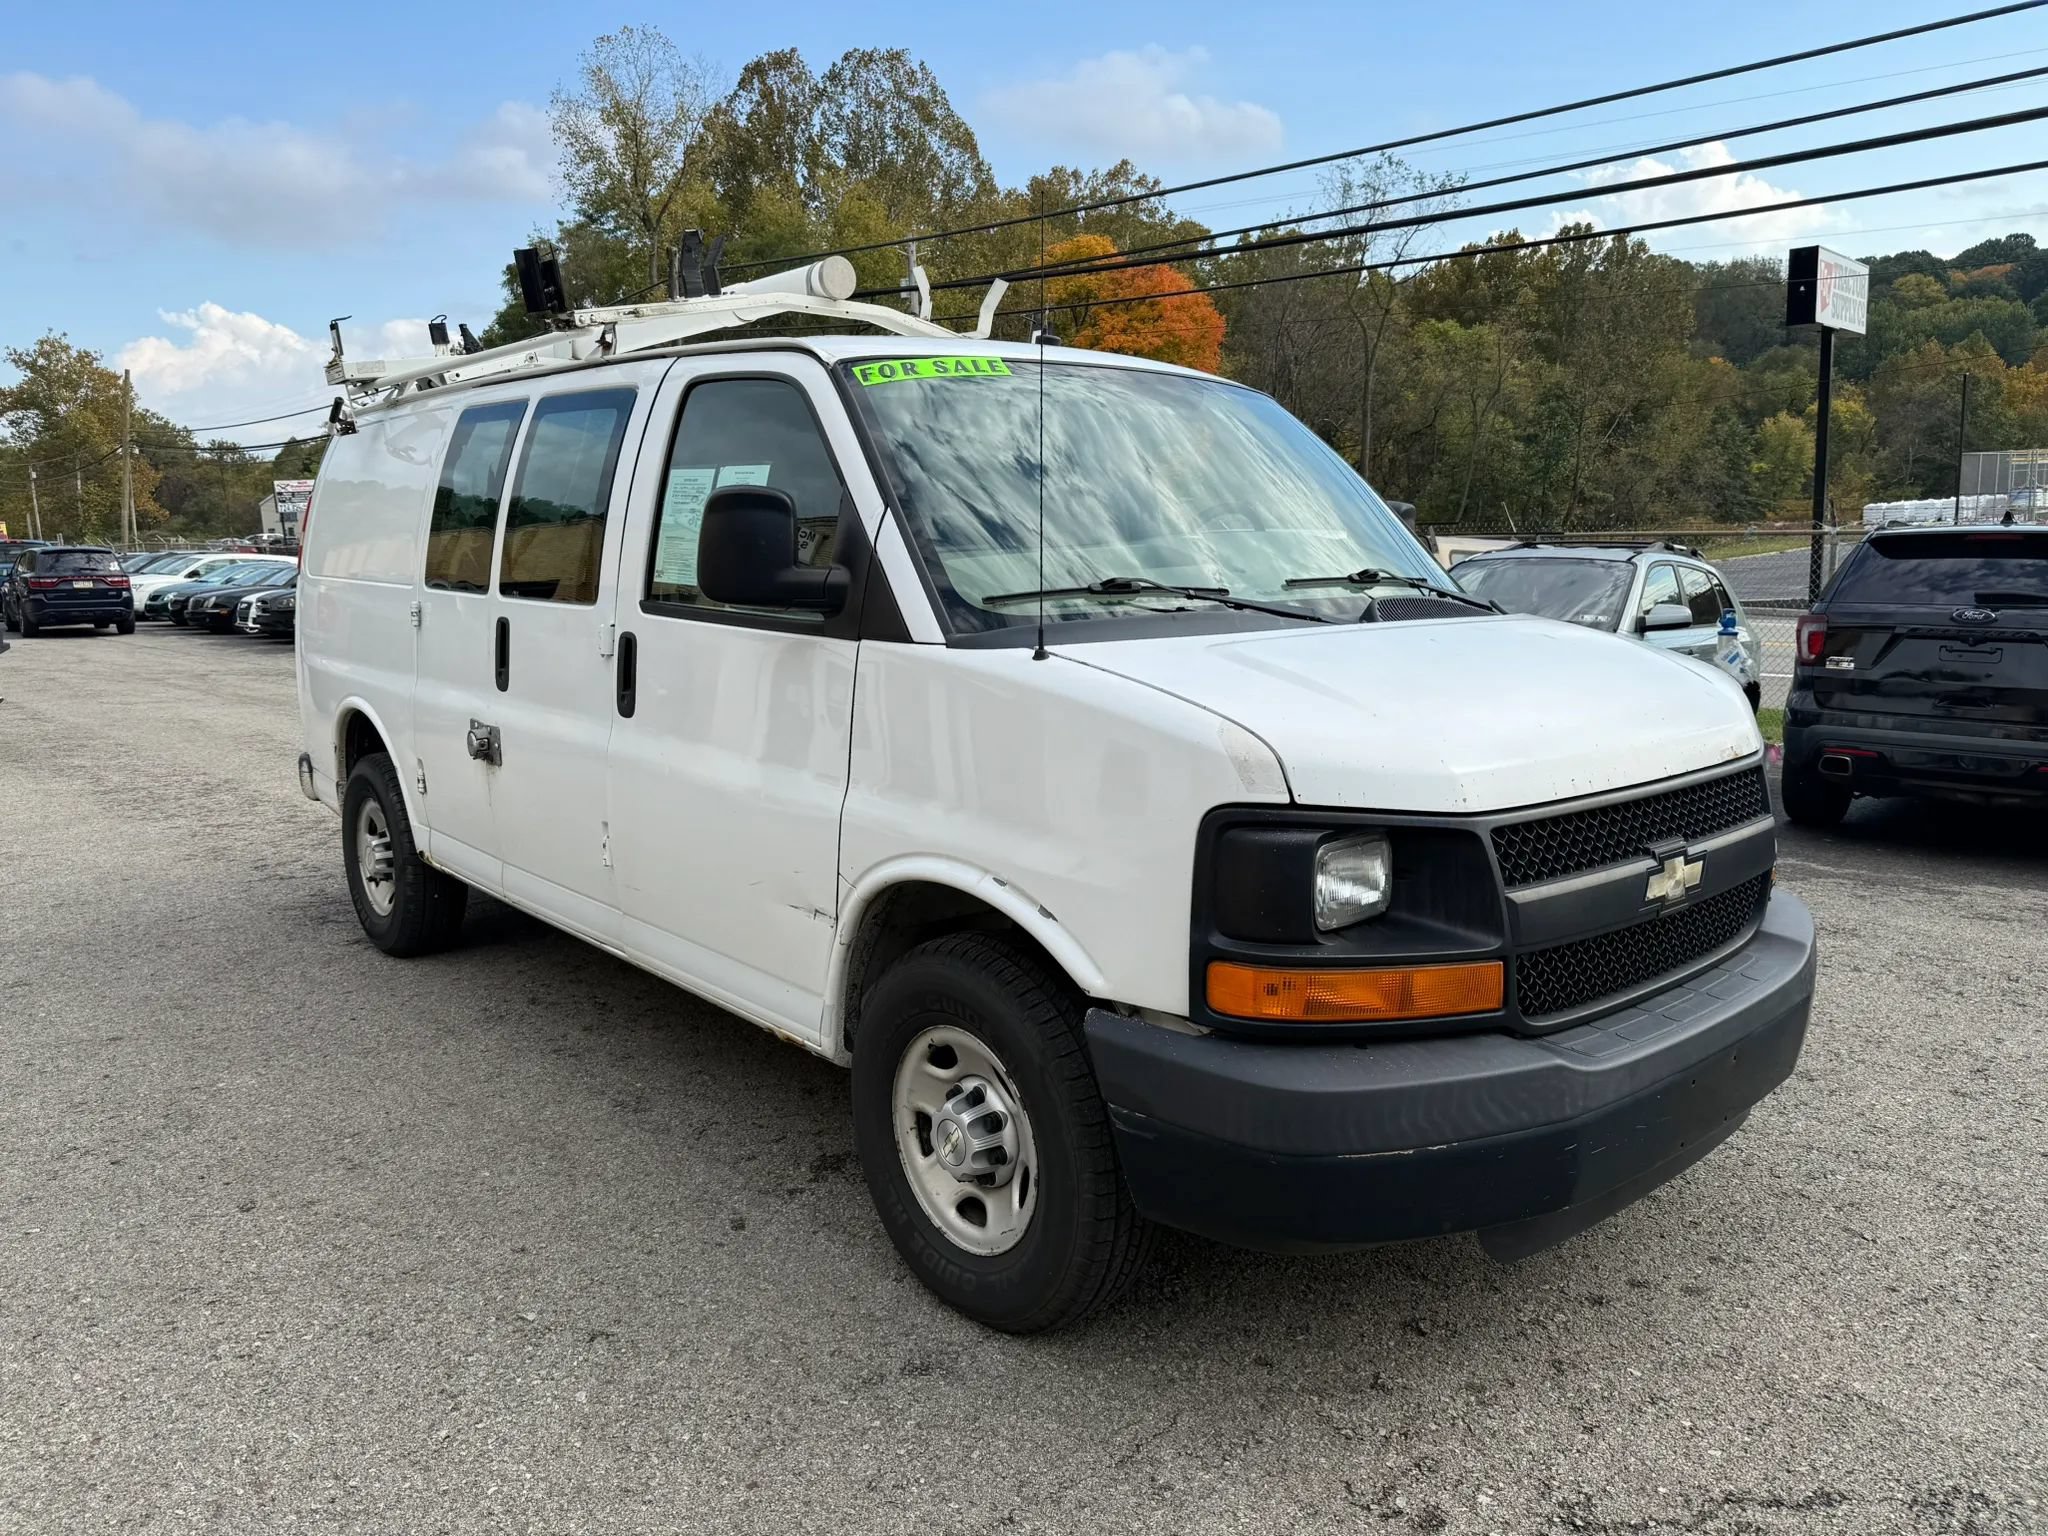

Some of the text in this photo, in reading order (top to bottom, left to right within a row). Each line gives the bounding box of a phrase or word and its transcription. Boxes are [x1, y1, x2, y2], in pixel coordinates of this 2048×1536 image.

[859, 359, 1006, 383] FOR SALE
[1961, 610, 1986, 620] Ford
